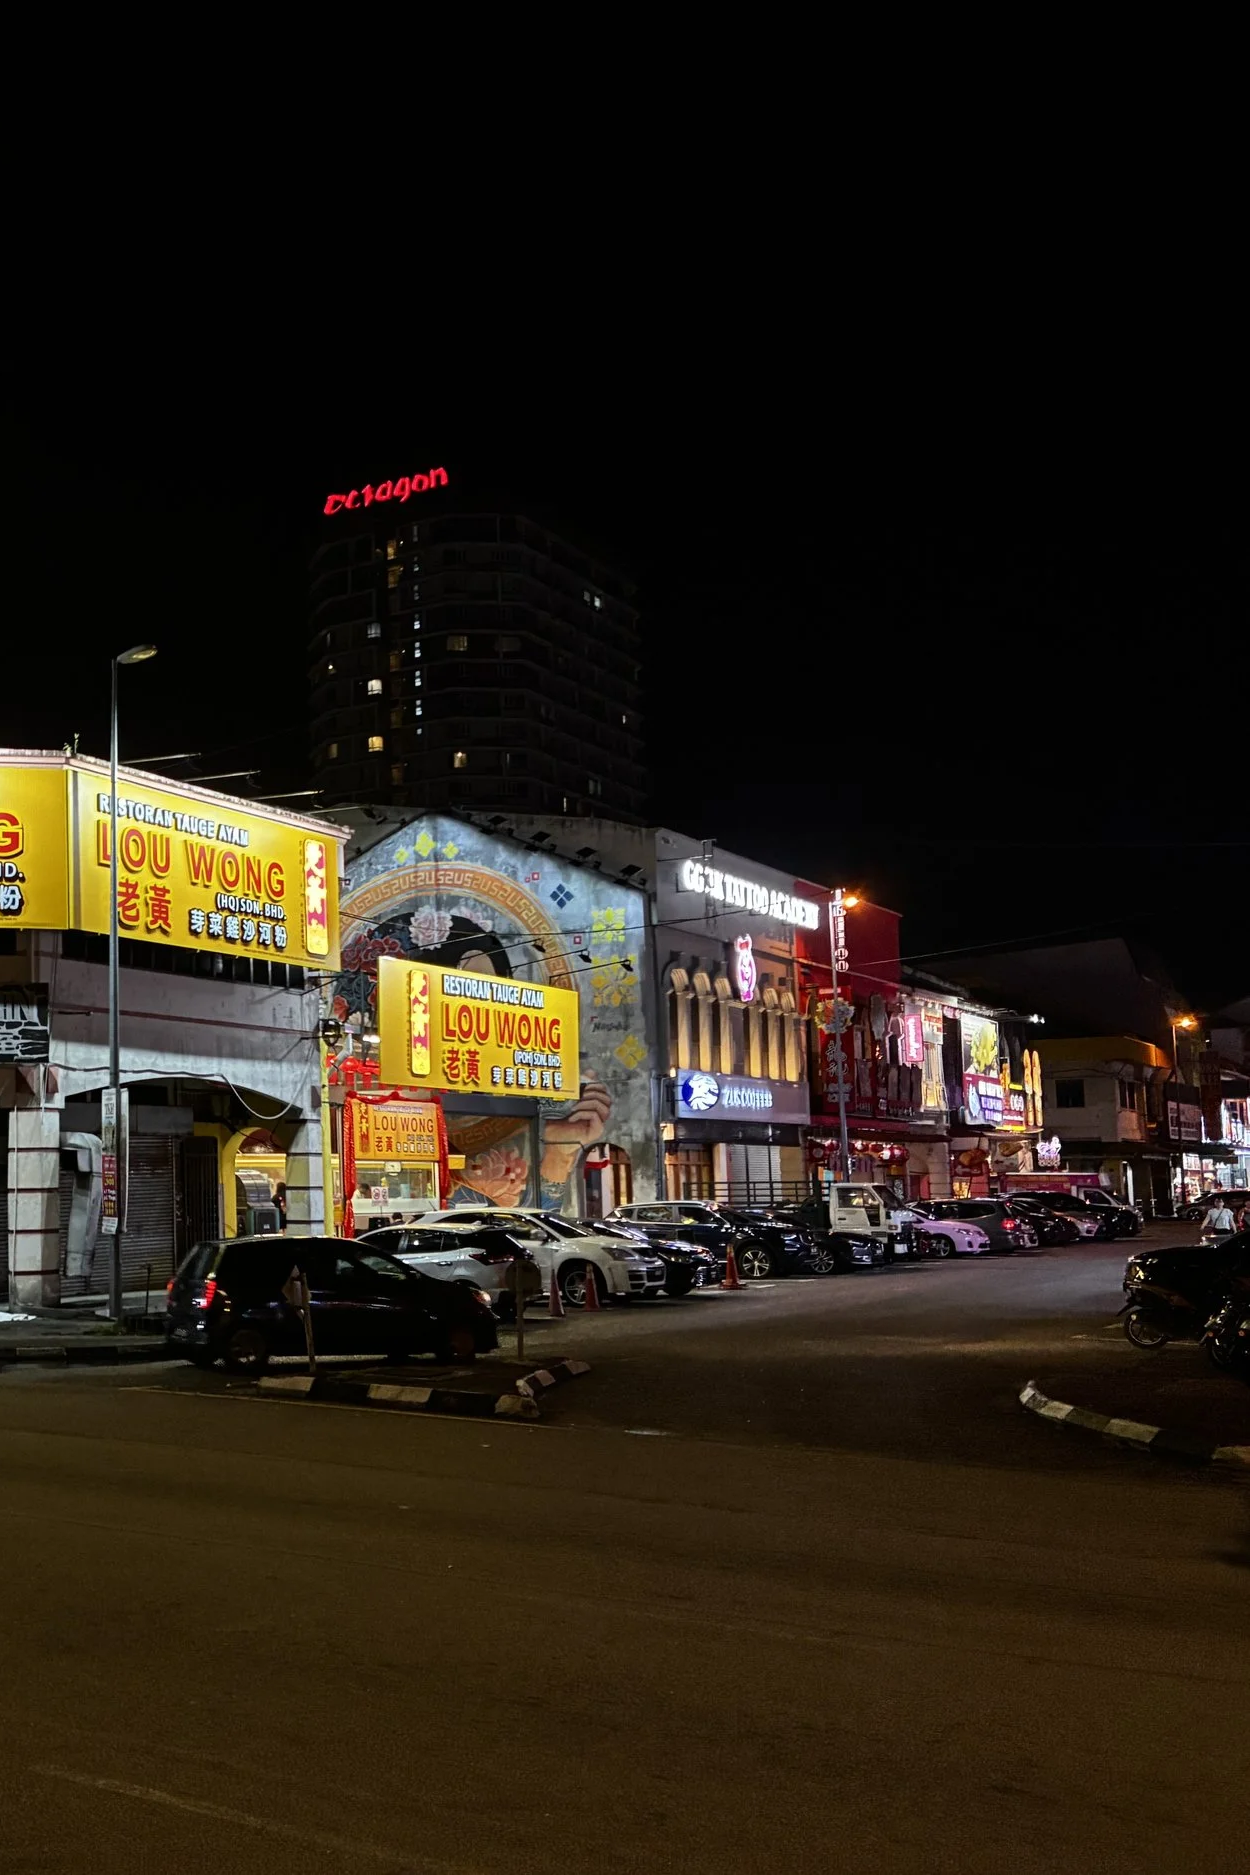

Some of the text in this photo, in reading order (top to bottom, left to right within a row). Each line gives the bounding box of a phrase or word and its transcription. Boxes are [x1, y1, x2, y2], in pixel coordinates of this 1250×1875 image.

[99, 794, 249, 847] RSTORAN TAUGE AYAM
[101, 823, 171, 875] LOU
[190, 844, 285, 899] WONG
[117, 880, 172, 930] 老黃
[443, 975, 544, 1008] RESTORAN TAUGE AYAM
[445, 1003, 490, 1042] LOU
[497, 1010, 561, 1050] WONG
[446, 1049, 481, 1081] 老黃
[374, 1115, 434, 1133] LOU WONG
